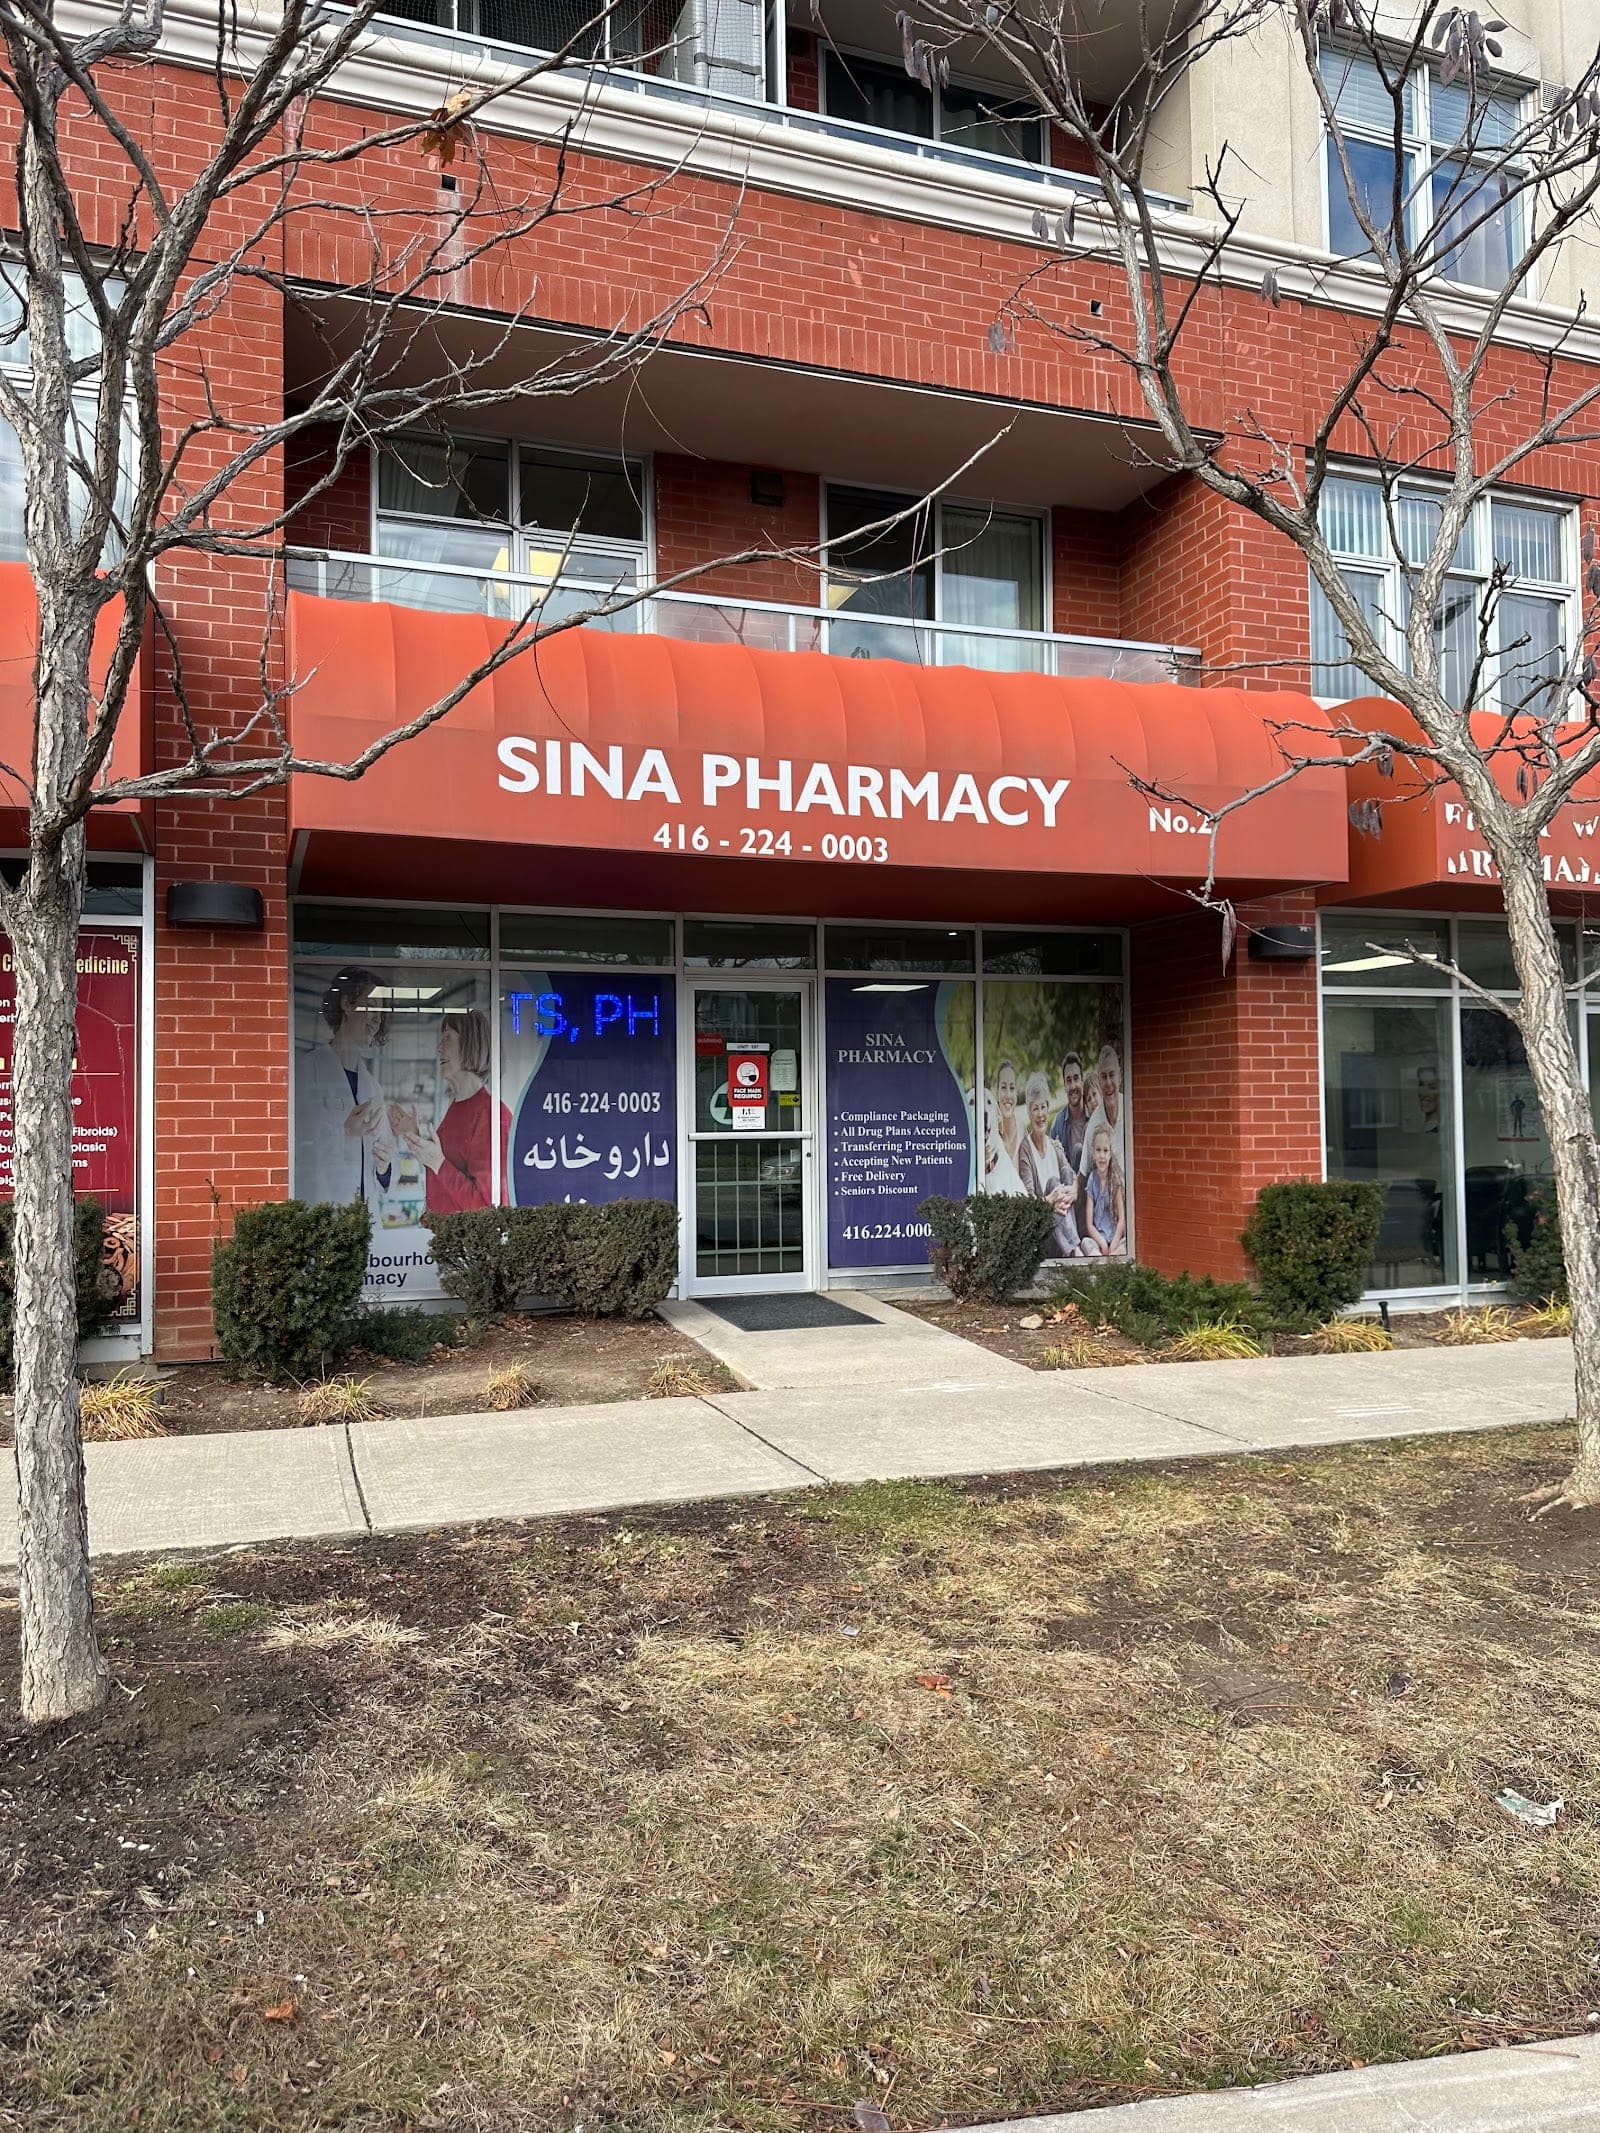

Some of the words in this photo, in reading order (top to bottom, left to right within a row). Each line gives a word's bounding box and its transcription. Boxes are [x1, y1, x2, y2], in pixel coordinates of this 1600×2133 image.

[497, 736, 682, 804] SINA
[702, 753, 1071, 829] PHARMACY
[653, 822, 709, 852] 416
[739, 827, 793, 857] 224
[821, 833, 890, 864] 0003
[75, 955, 129, 974] edicine
[594, 993, 661, 1037] PH
[865, 1033, 906, 1047] SINA
[838, 1049, 937, 1064] PHARMACY
[542, 1092, 661, 1115] 416-224-0003
[840, 1111, 898, 1124] Compliance
[900, 1110, 950, 1123] Packaging
[72, 1126, 118, 1138] Fibroids)
[840, 1126, 855, 1137] All
[857, 1126, 883, 1139] Drug
[885, 1125, 912, 1136] Plans
[913, 1125, 957, 1138] Accepted
[840, 1141, 902, 1154] Transferring
[904, 1140, 967, 1153] Prescriptions
[523, 1131, 670, 1180] داروخانه
[840, 1155, 889, 1169] Accepting
[891, 1155, 913, 1166] New
[915, 1154, 953, 1166] Patients
[841, 1171, 863, 1182] Free
[865, 1170, 906, 1183] Delivery
[840, 1185, 876, 1197] Seniors
[878, 1184, 919, 1195] Discount
[842, 1222, 935, 1240] 416.224.000
